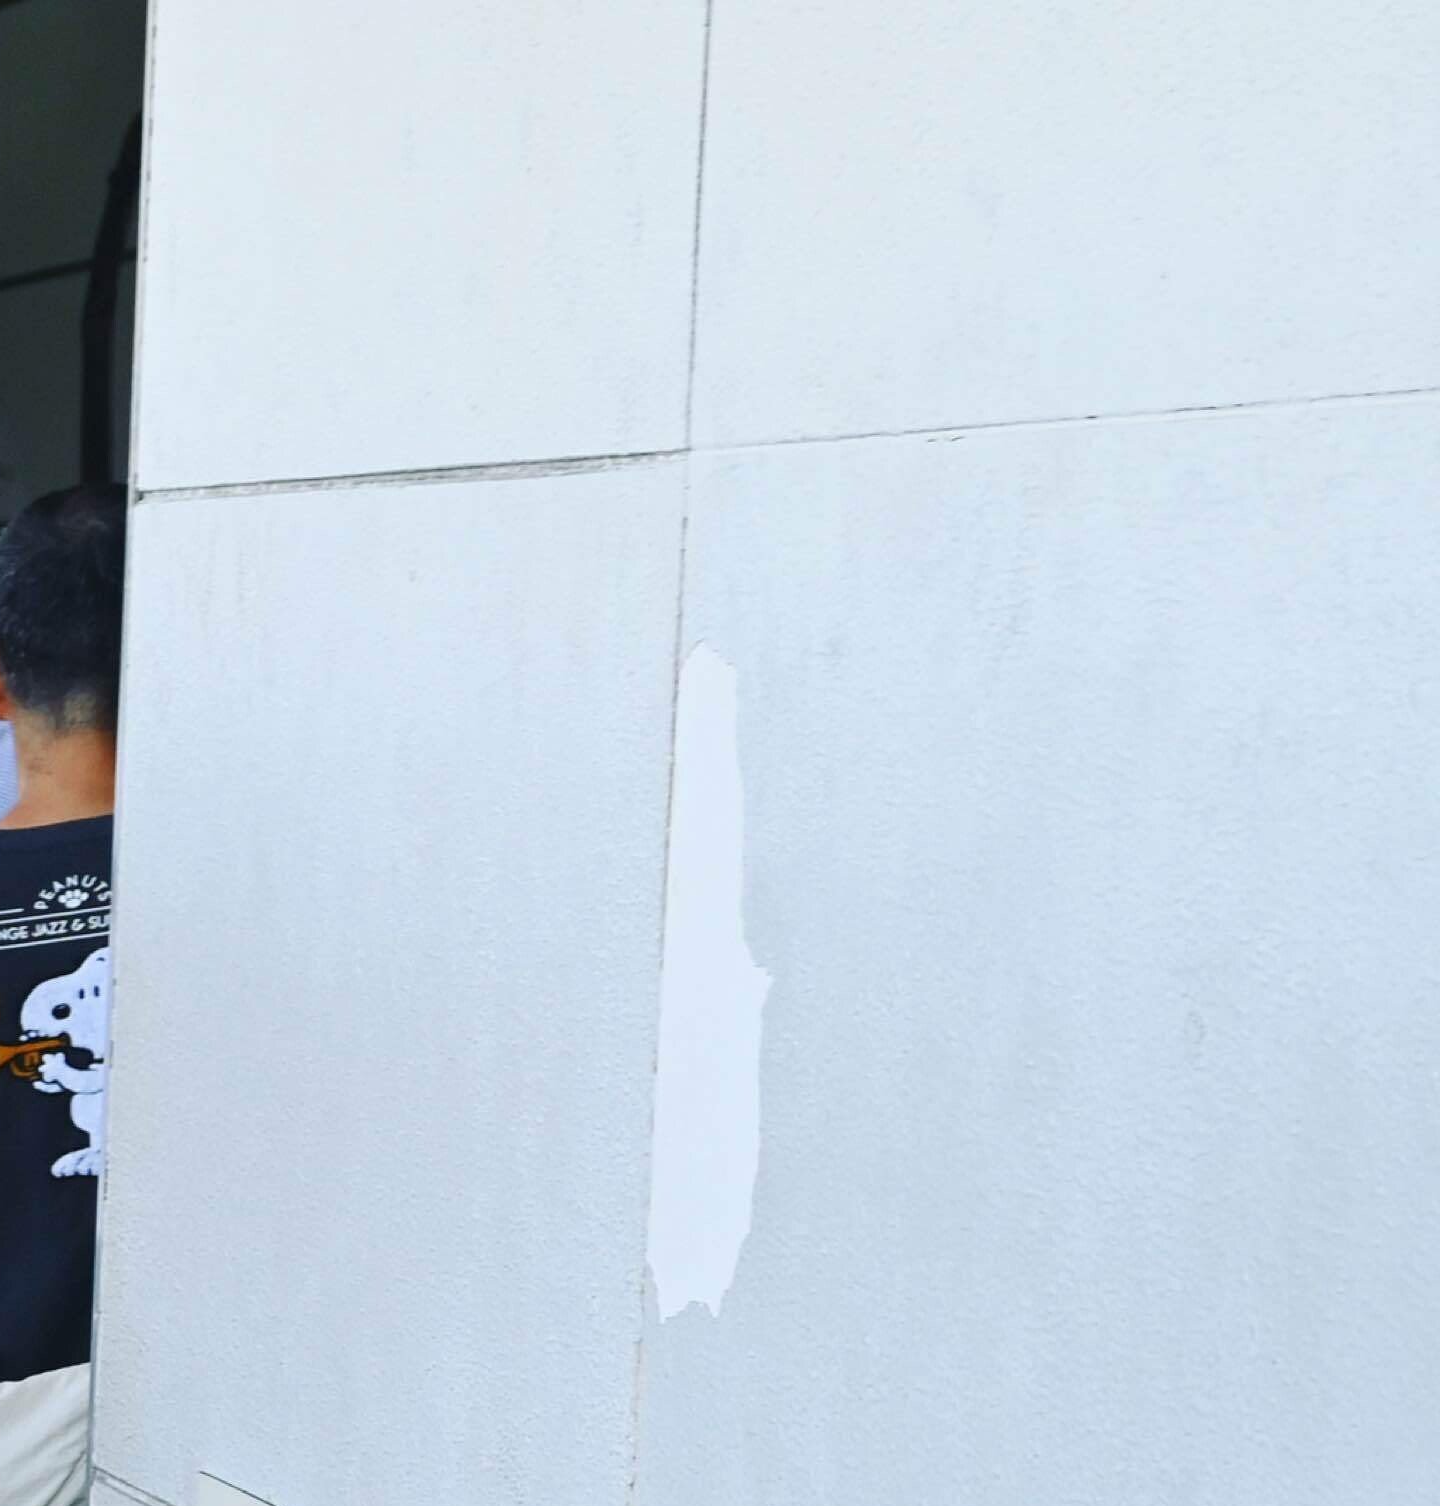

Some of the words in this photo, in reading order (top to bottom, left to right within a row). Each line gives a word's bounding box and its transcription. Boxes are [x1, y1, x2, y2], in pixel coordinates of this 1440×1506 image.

[33, 874, 113, 910] PEANUTS
[31, 919, 69, 938] JAZZ
[71, 917, 86, 931] &
[88, 912, 113, 930] SU
